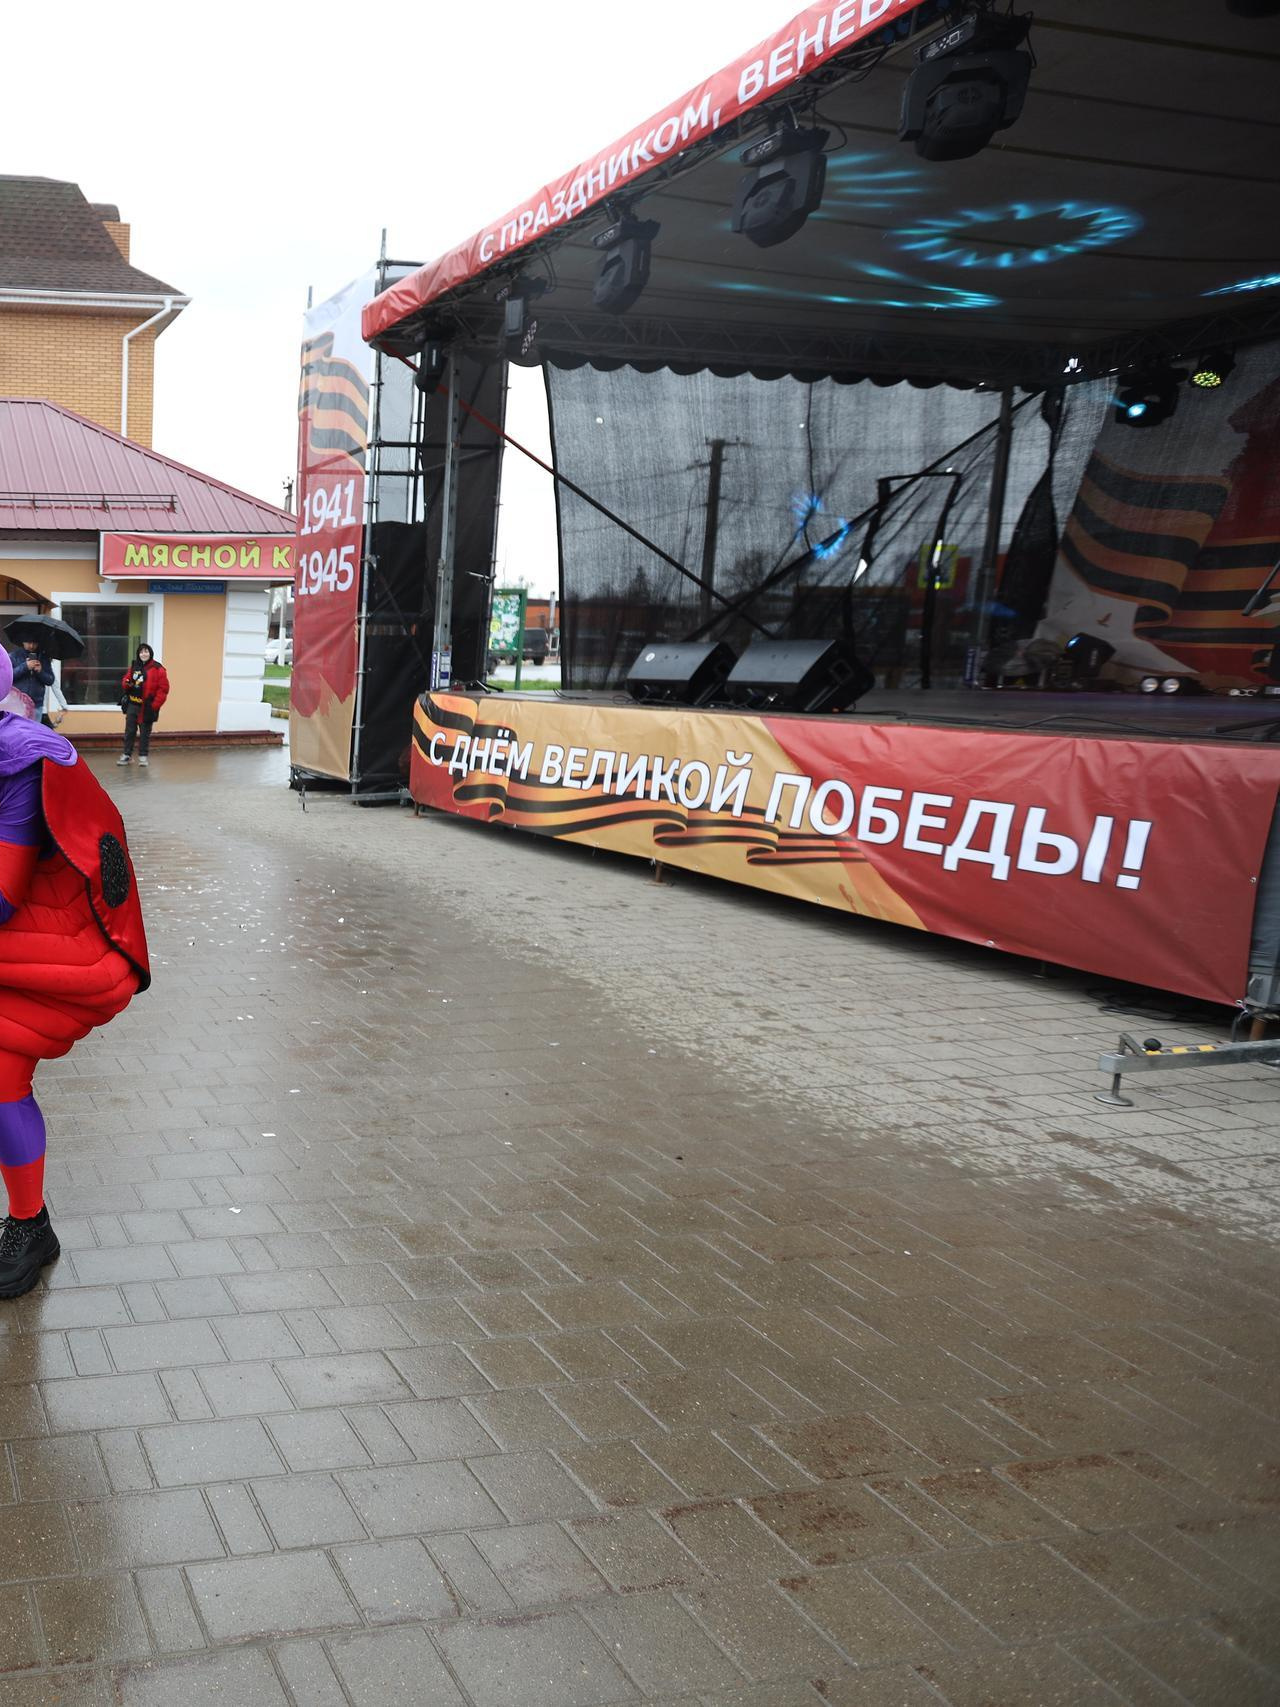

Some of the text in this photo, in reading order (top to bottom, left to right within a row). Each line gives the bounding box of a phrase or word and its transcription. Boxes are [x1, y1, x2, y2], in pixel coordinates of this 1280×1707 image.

[479, 234, 495, 262] С
[500, 92, 721, 252] ПРАЗДНИКОМ,
[300, 479, 357, 536] 1941
[124, 540, 296, 569] МЯСНОЙ К
[298, 545, 355, 596] 1945
[429, 729, 1152, 890] С ДНЁМ ВЕЛИКОЙ ПОБЕДЫ!
